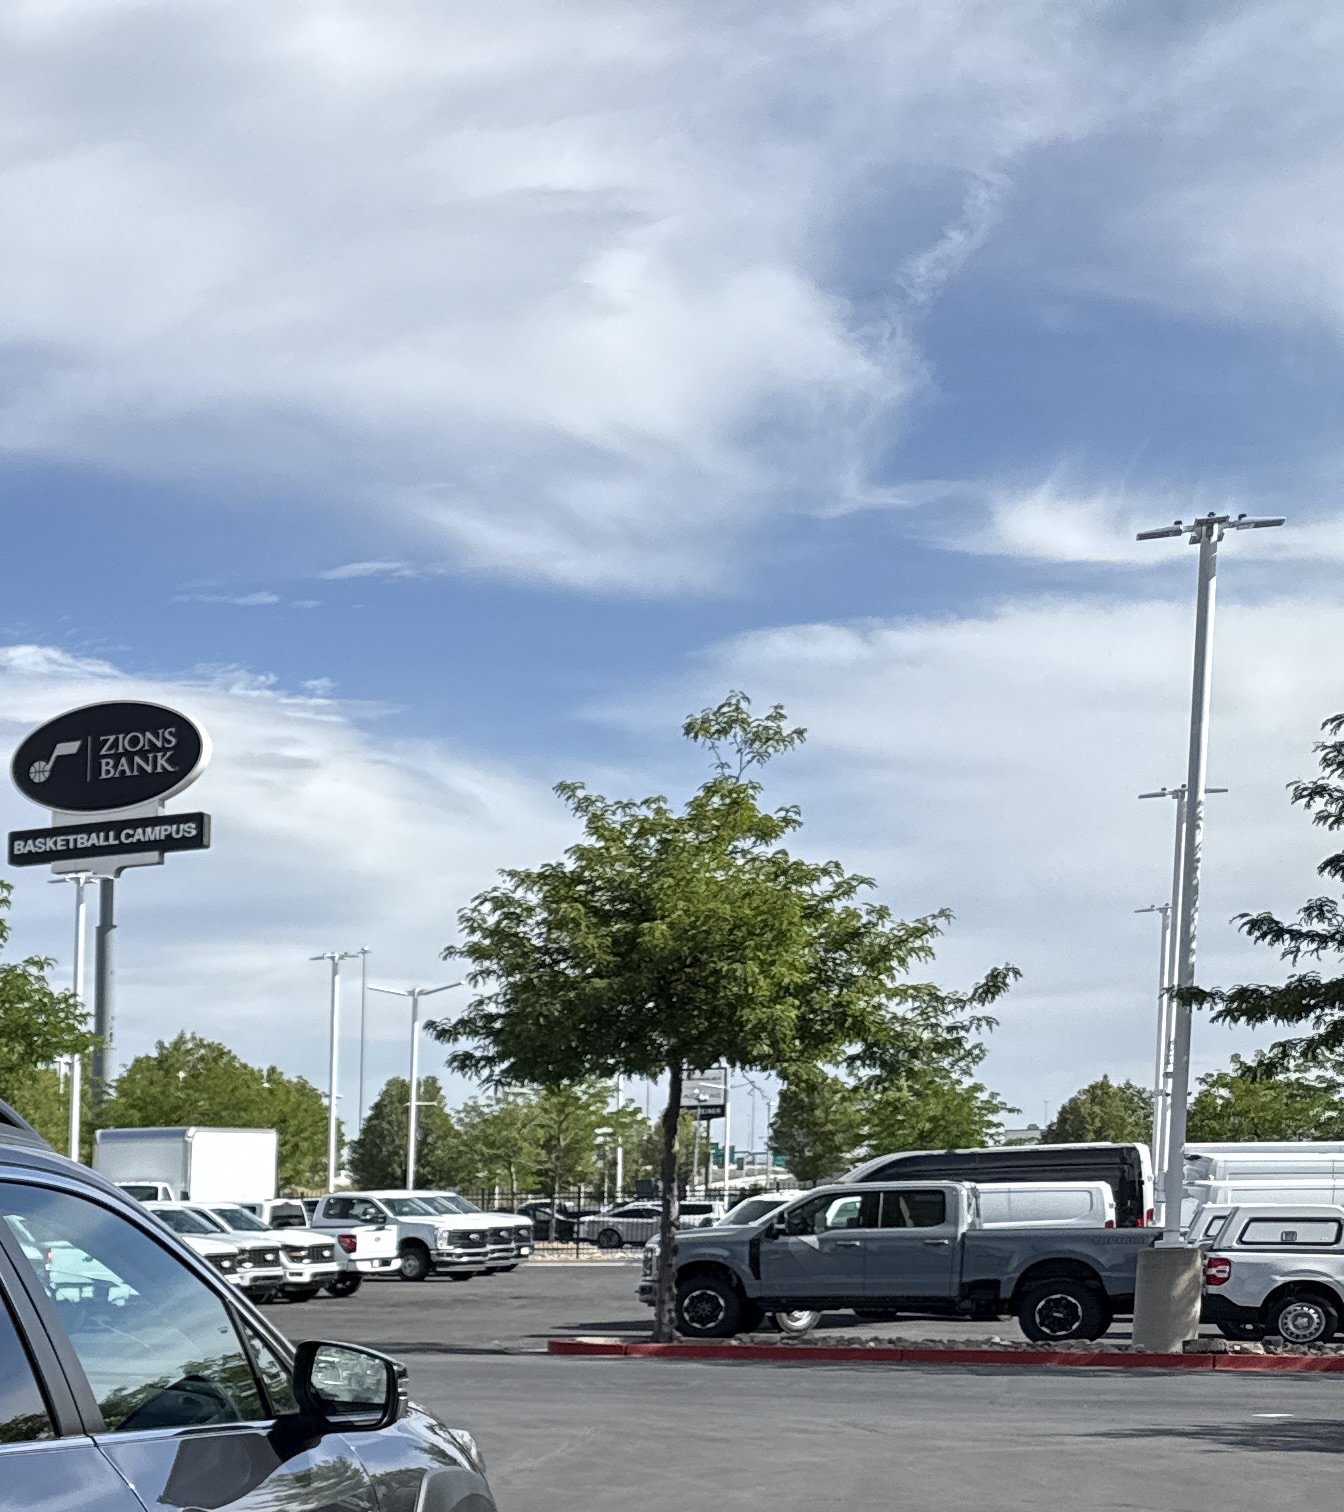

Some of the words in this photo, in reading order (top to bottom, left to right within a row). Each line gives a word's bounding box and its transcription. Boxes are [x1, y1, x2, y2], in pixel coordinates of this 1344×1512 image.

[99, 727, 177, 756] ZIONS
[98, 751, 176, 780] BANK
[13, 831, 119, 855] BASKETBALL
[120, 822, 198, 844] CAMPUS
